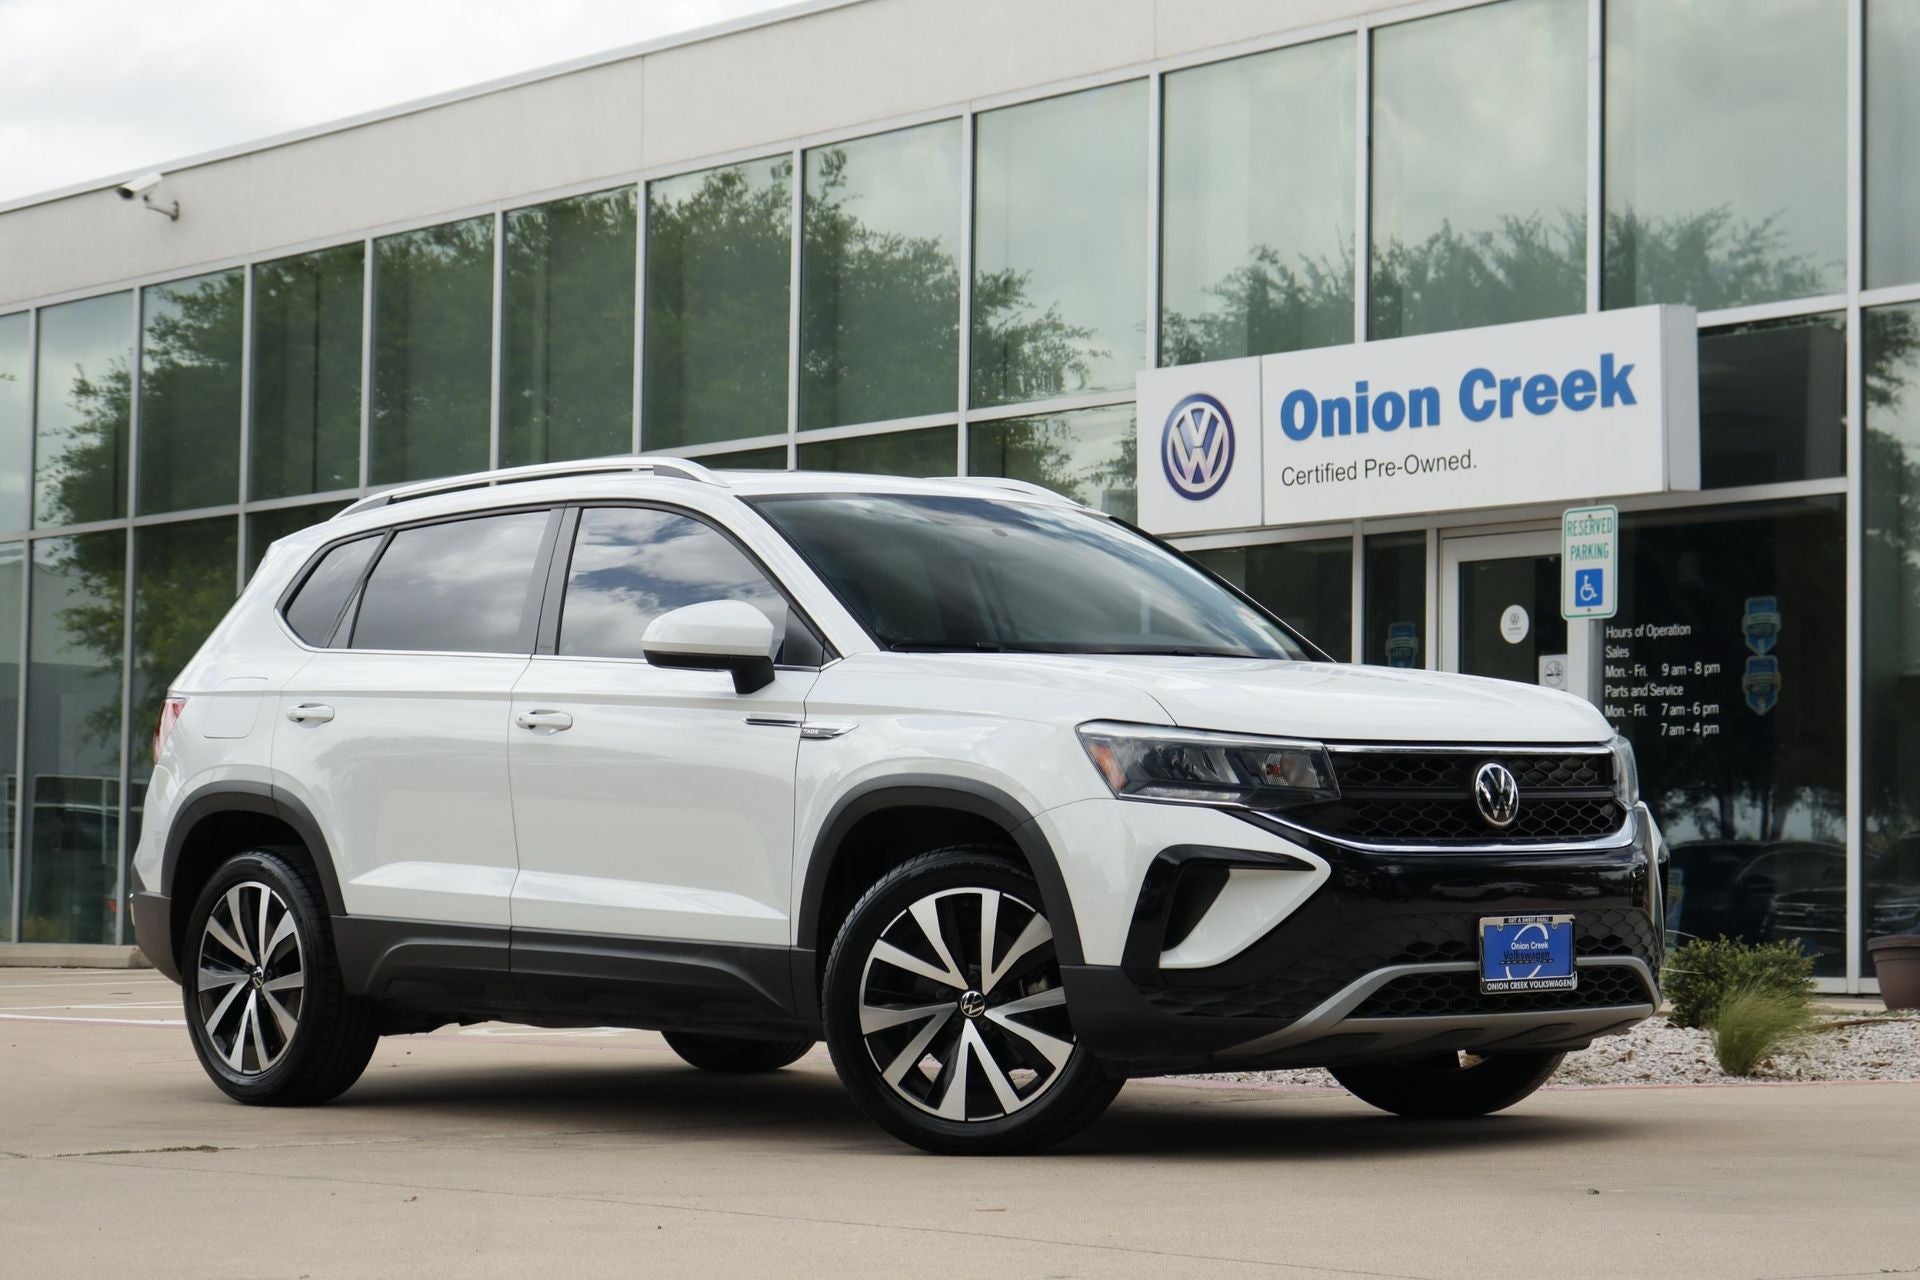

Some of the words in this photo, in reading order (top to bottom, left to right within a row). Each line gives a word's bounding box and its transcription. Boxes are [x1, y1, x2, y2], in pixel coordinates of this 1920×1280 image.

[1280, 380, 1440, 441] Onion
[1459, 352, 1638, 423] Creek
[1281, 460, 1358, 487] Certified
[1364, 449, 1478, 479] Pre-Owned.
[1567, 517, 1613, 537] RESERVED
[1570, 542, 1609, 561] PARKING
[1605, 625, 1633, 639] Hours
[1634, 624, 1644, 637] of
[1645, 624, 1691, 639] Operation
[1605, 645, 1630, 658] Sales
[1605, 664, 1627, 678] Mon.
[1634, 664, 1648, 677] Fri.
[1661, 663, 1669, 676] 9
[1671, 665, 1687, 676] am
[1694, 661, 1702, 675] 8
[1704, 663, 1720, 677] pm
[1605, 685, 1629, 698] Parts
[1630, 684, 1648, 697] and
[1649, 683, 1684, 697] Service
[1605, 704, 1626, 718] Mon.
[1634, 703, 1648, 717] Fri.
[1661, 703, 1668, 716] 7
[1669, 704, 1686, 716] am
[1692, 702, 1701, 715] 6
[1702, 703, 1719, 718] pm
[1660, 723, 1668, 736] 7
[1669, 725, 1685, 736] am
[1692, 722, 1701, 735] 4
[1702, 724, 1719, 738] pm
[1511, 941, 1530, 950] Onion
[1530, 941, 1549, 950] Creek
[1503, 950, 1551, 962] Volkswagen
[1487, 982, 1509, 991] ONION
[1510, 981, 1528, 990] CREEK
[1529, 979, 1573, 989] VOLKSWAGEN
